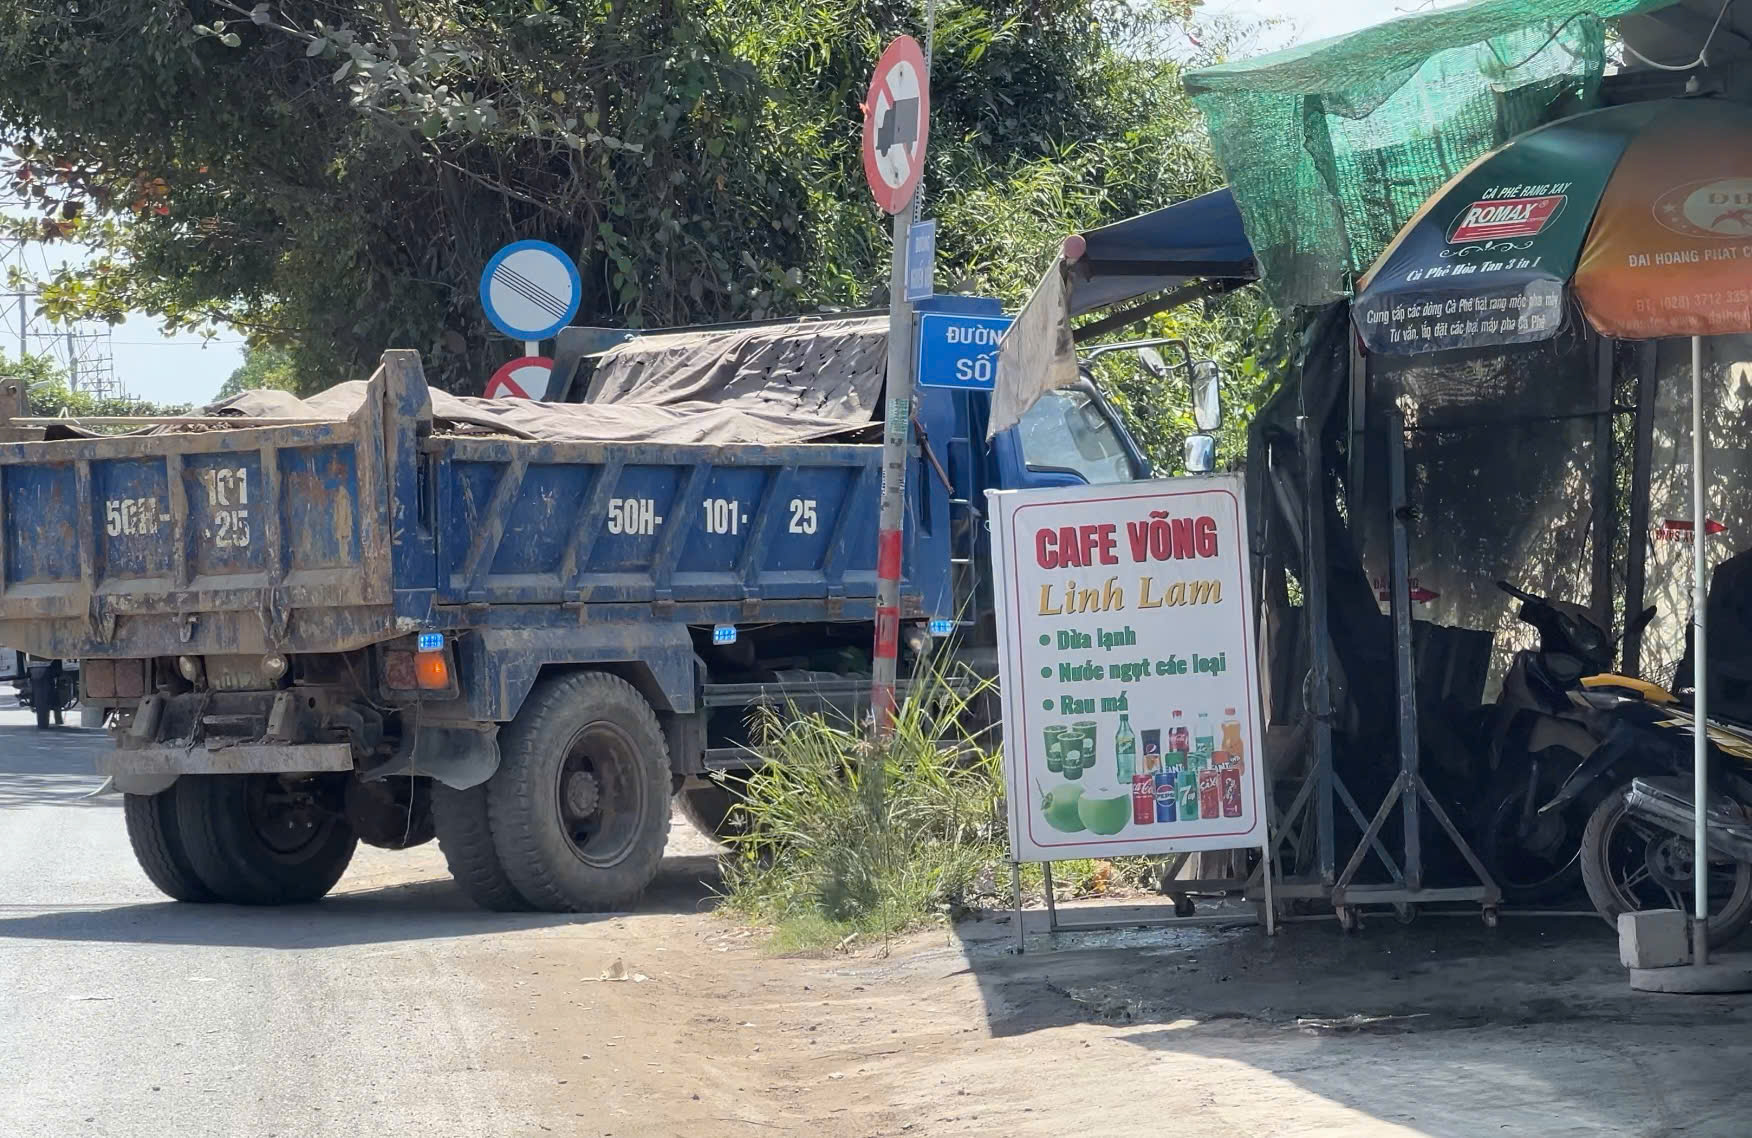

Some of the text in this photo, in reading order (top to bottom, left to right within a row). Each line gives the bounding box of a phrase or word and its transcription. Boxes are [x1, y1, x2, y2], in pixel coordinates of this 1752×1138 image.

[1498, 184, 1522, 199] PHÊ
[1520, 184, 1548, 197] RANG
[1549, 182, 1572, 195] XAY
[1461, 203, 1537, 227] ROMAX
[1743, 246, 1752, 257] C
[1424, 265, 1451, 279] Phê
[1480, 261, 1503, 272] Tan
[1505, 259, 1515, 269] 3
[1516, 259, 1530, 268] in
[1367, 309, 1389, 324] Cung
[1392, 303, 1405, 322] cấp
[1407, 304, 1421, 318] các
[1423, 301, 1443, 317] dòng
[1459, 297, 1473, 313] Phê
[1489, 298, 1507, 312] rang
[946, 325, 1003, 345] ĐƯỜN
[1390, 328, 1401, 343] Tư
[1450, 320, 1464, 335] các
[1481, 316, 1498, 333] máy
[1500, 317, 1515, 333] pha
[955, 351, 999, 381] SỐ
[789, 499, 818, 534] 25
[1035, 510, 1219, 570] CAFE VÕNG
[1038, 576, 1222, 616] Linh Lam
[1057, 626, 1136, 651] Dừa lạnh
[1059, 652, 1226, 683] Nước ngọt các loại
[1060, 690, 1129, 715] Rau má
